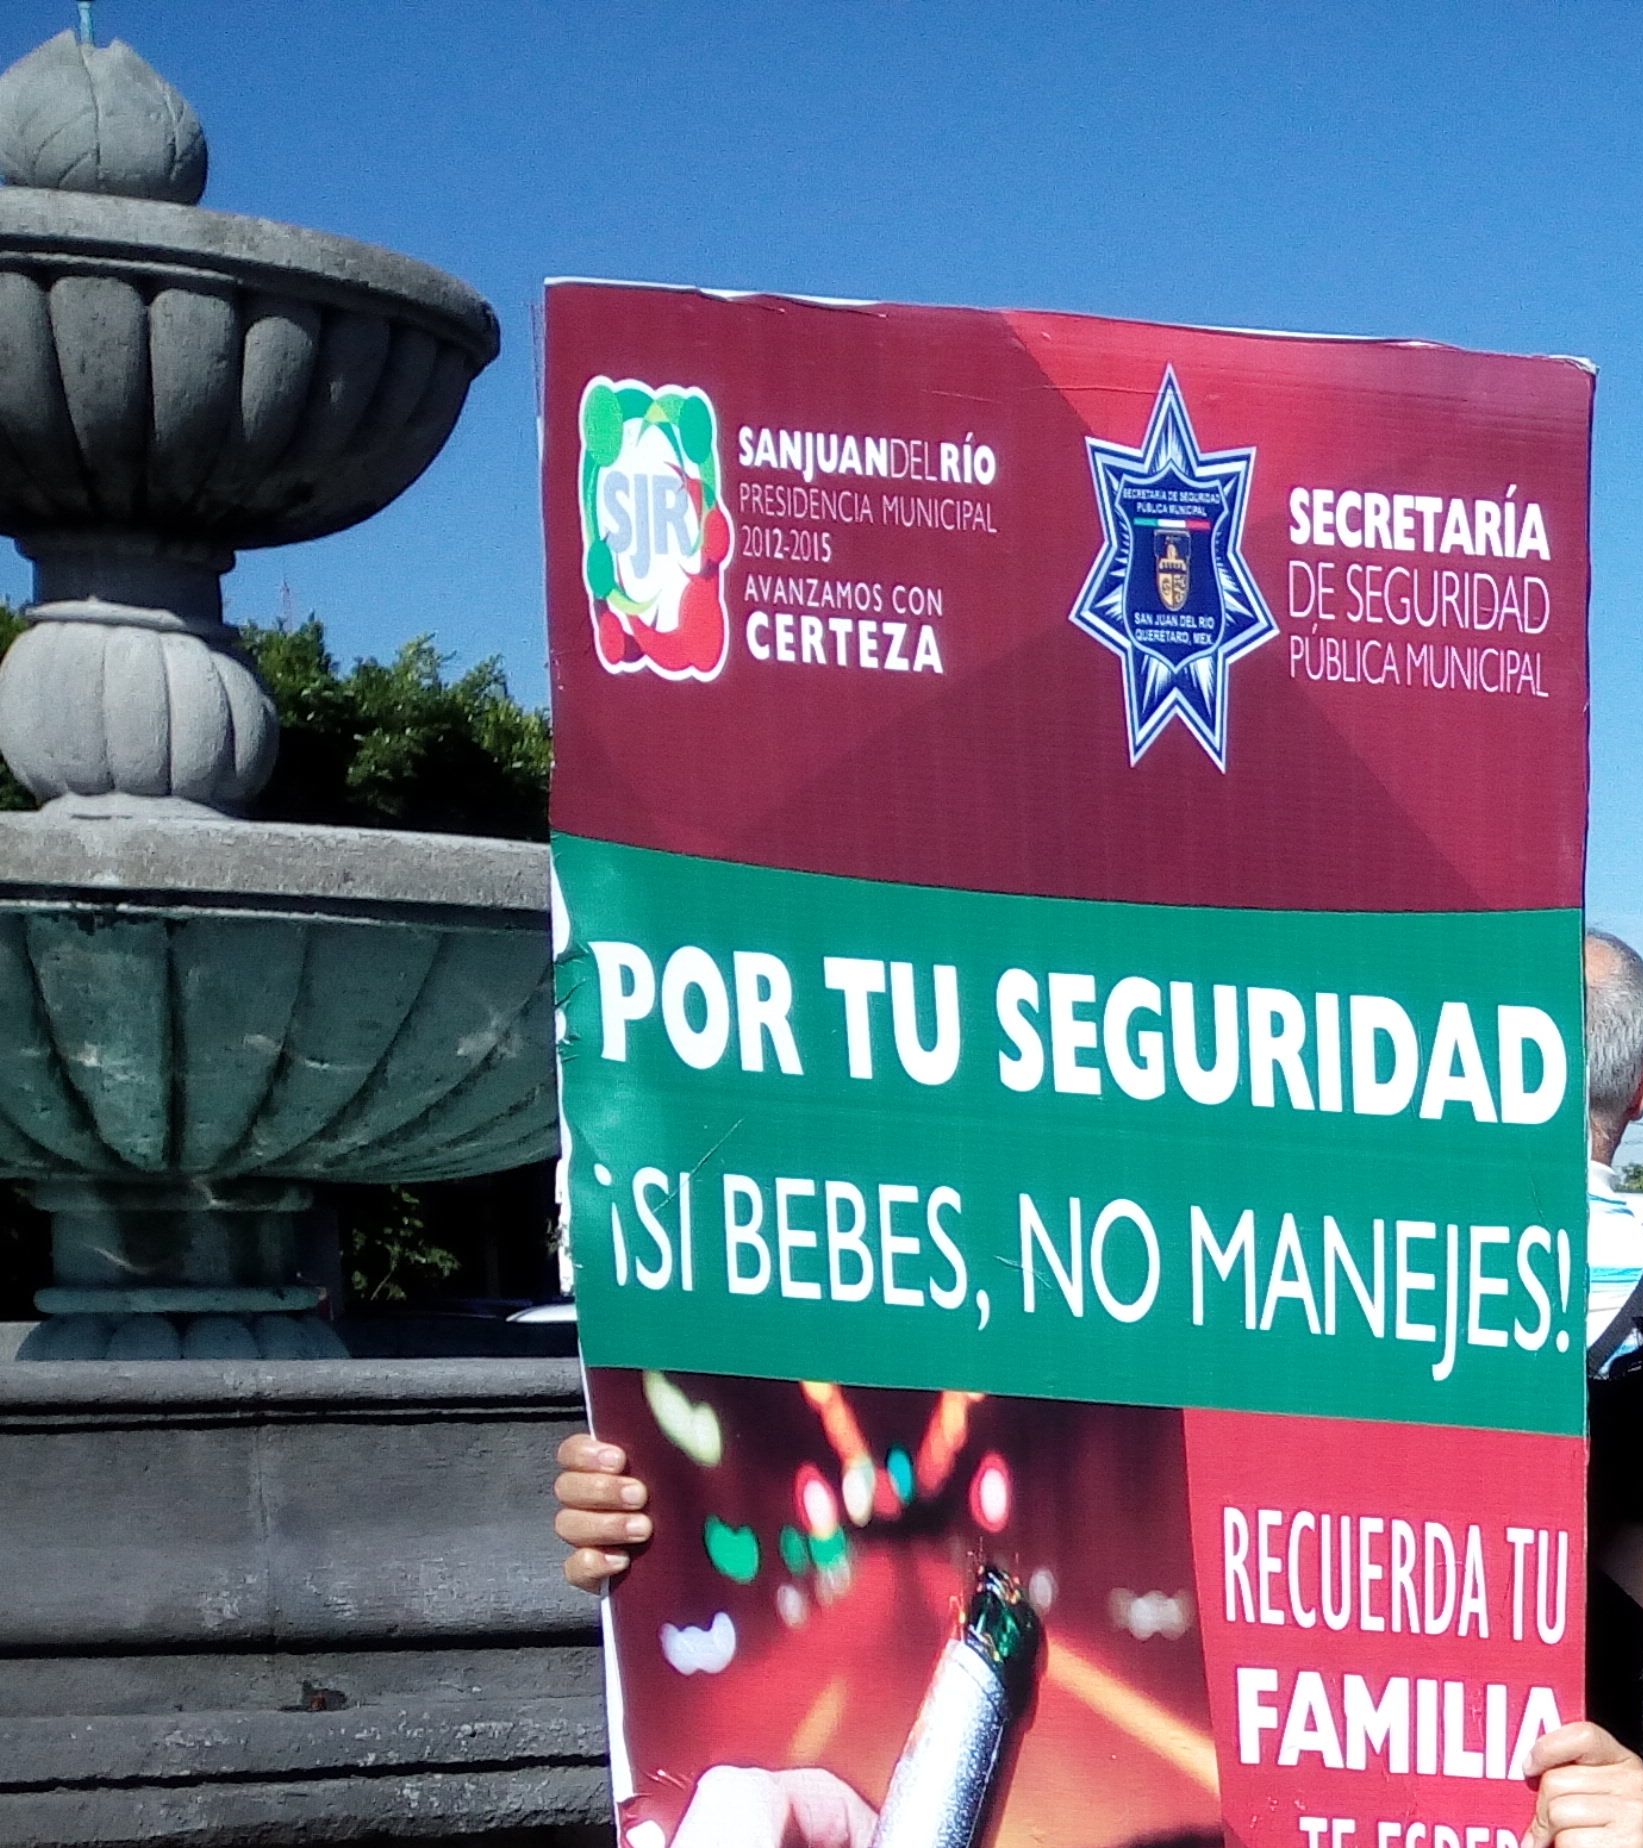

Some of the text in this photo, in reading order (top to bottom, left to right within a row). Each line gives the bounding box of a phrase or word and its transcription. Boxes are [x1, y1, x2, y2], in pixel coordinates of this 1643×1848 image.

[739, 483, 998, 534] PRESIDENCIA MUNICIPAL
[741, 526, 832, 564] 2012-2015
[1289, 485, 1551, 561] SECRETARÍA
[744, 575, 943, 617] AVANZAMOS CON
[1134, 612, 1153, 625] SAN
[1155, 614, 1178, 626] JUAN
[1180, 615, 1197, 628] DEL
[1288, 560, 1550, 635] DE SEGURIDAD
[746, 611, 944, 674] CERTEZA
[1290, 624, 1550, 697] PÚBLICA MUNICIPAL
[597, 941, 1568, 1126] POR TU SEGURIDAD
[592, 1167, 1573, 1382] ¡SI BEBES, NO MANEJES!
[1223, 1506, 1569, 1645] RECUERDA TU
[1236, 1666, 1565, 1781] FAMILIA
